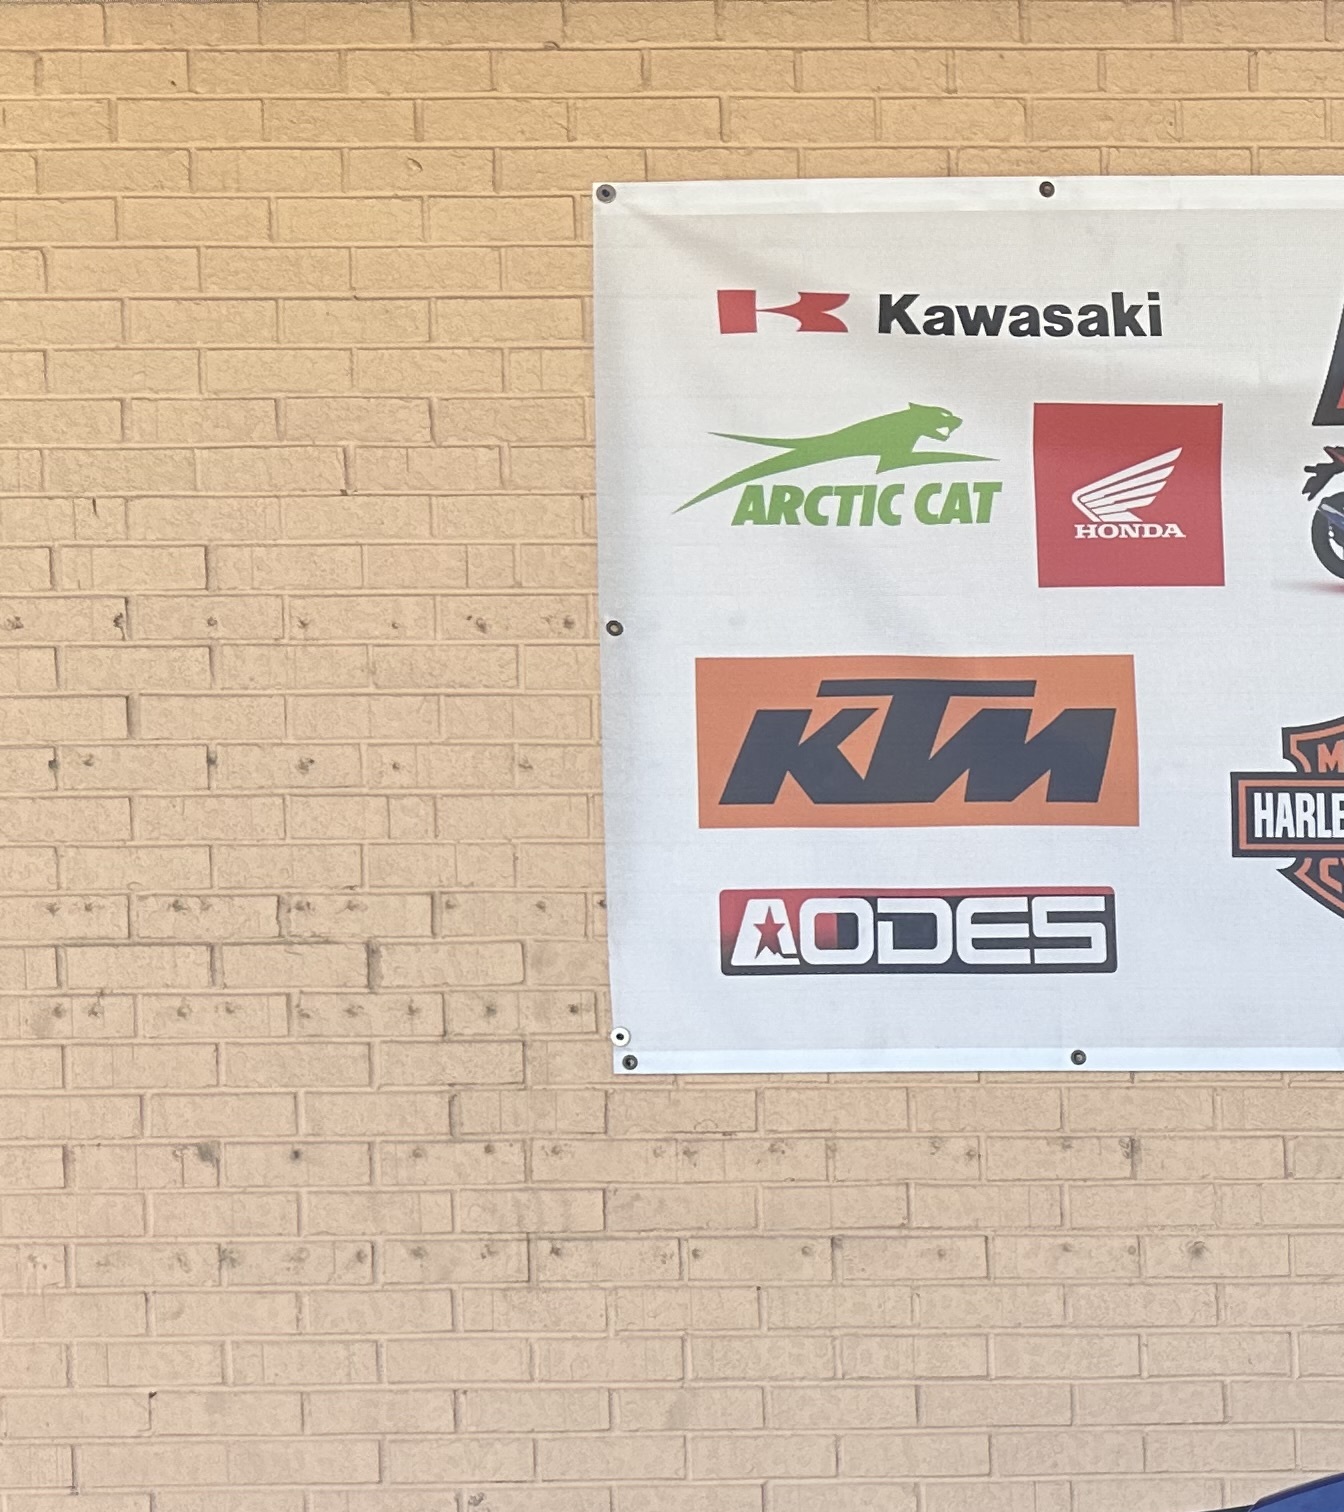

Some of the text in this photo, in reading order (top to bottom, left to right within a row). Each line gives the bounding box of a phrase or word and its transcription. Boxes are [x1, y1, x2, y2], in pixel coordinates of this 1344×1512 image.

[877, 290, 1164, 338] Kawasaki
[730, 481, 1003, 527] ARCTIC CAT
[1073, 522, 1187, 540] HONDA
[718, 678, 1117, 806] KTM
[729, 895, 1109, 967] AODES
